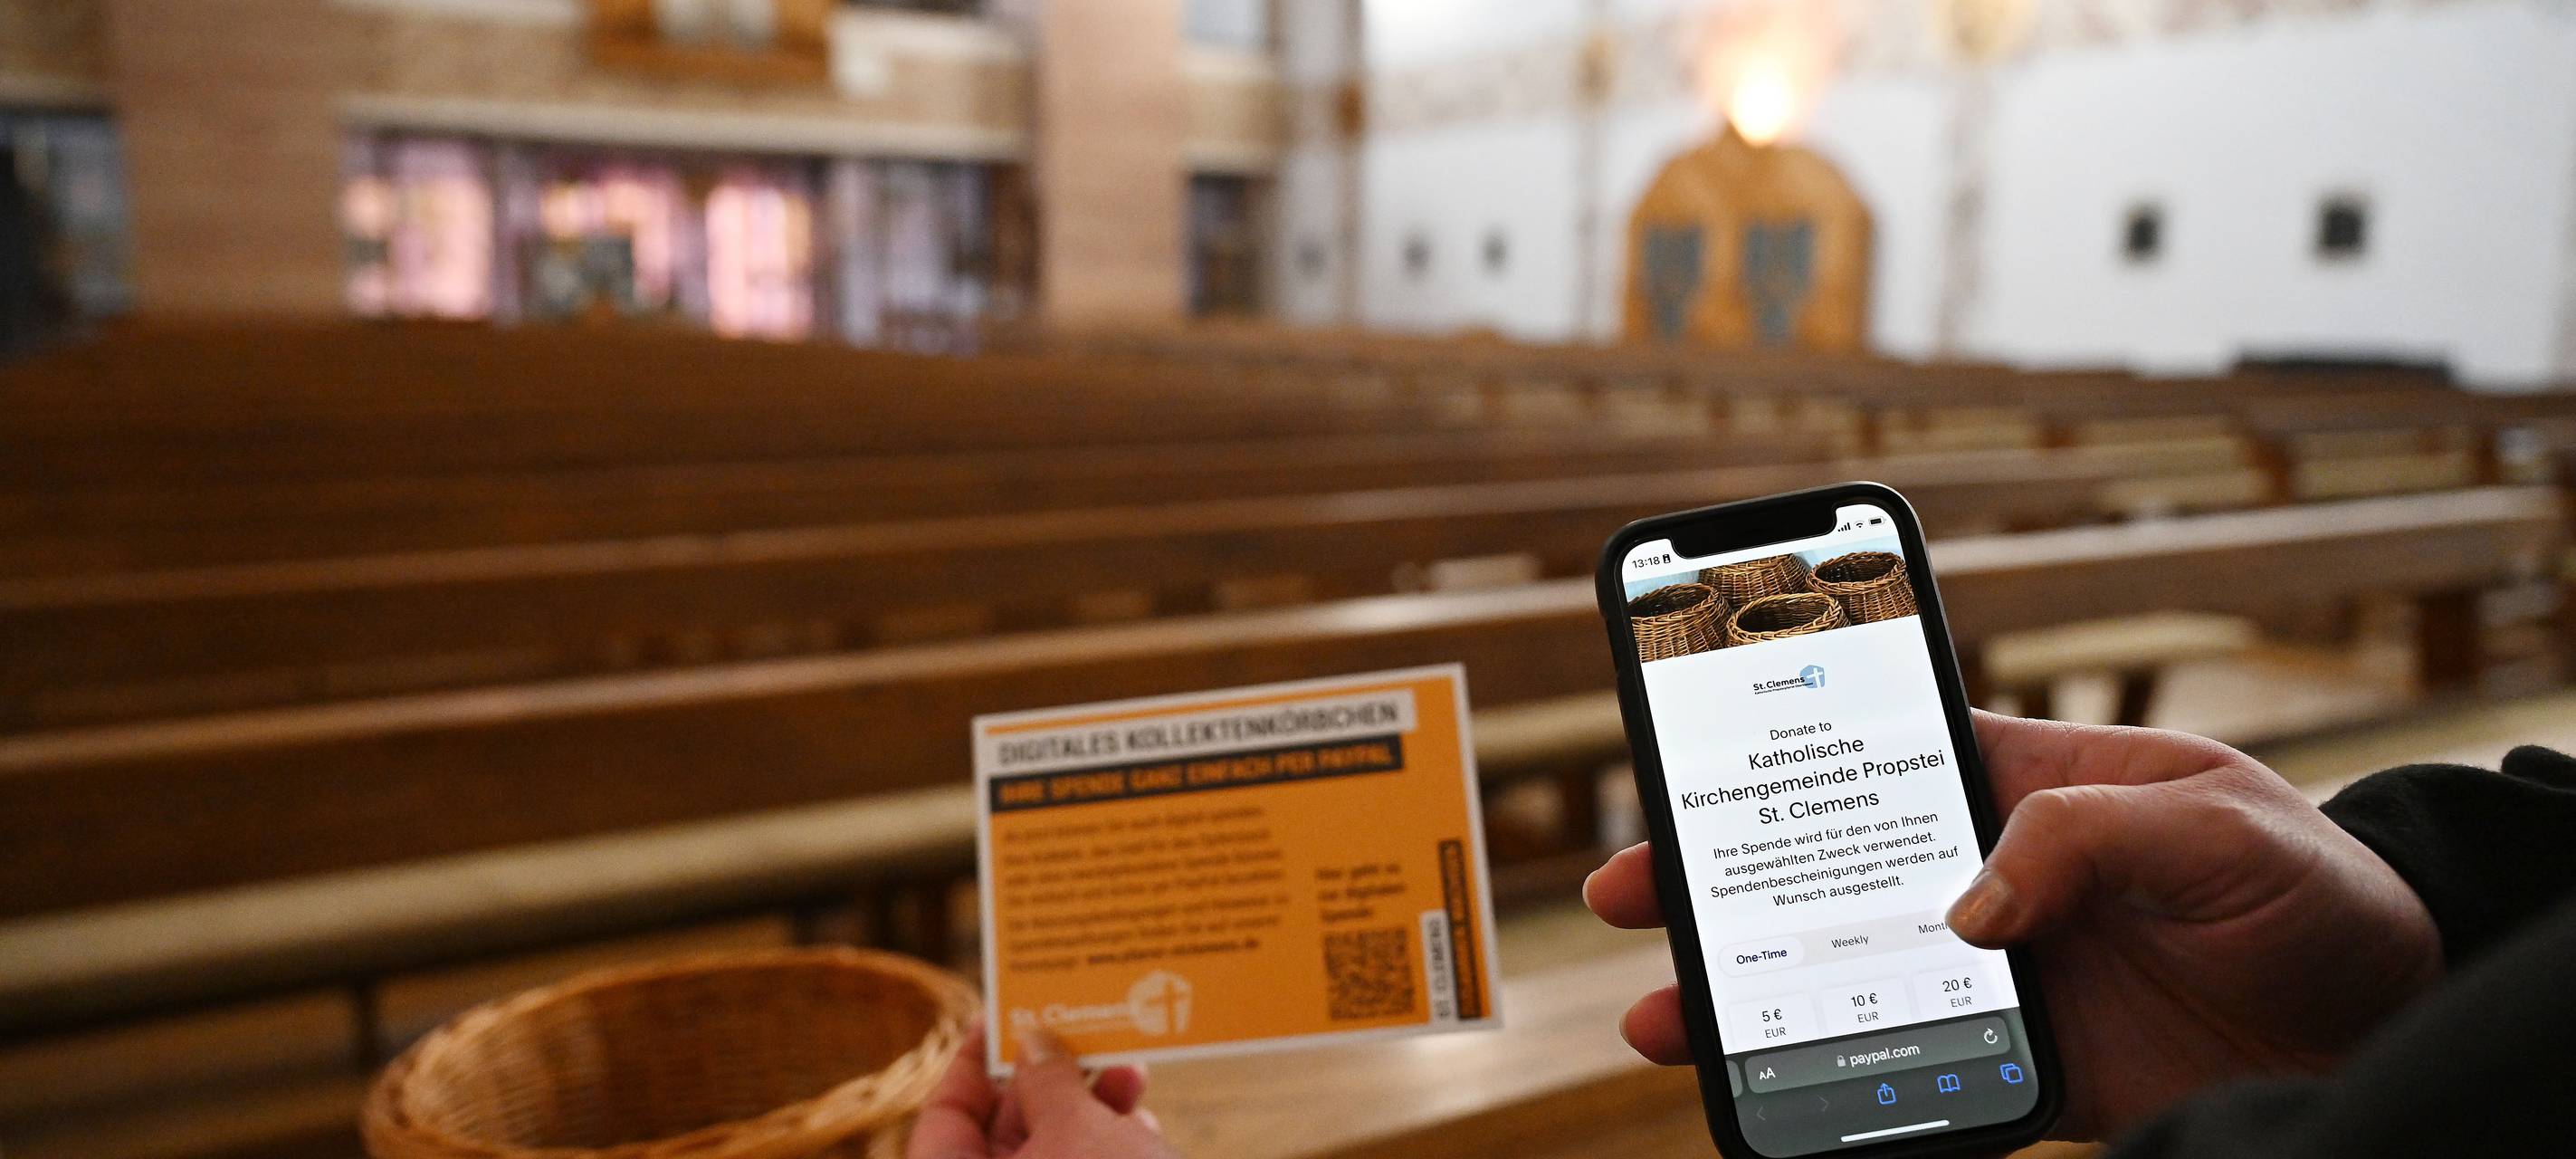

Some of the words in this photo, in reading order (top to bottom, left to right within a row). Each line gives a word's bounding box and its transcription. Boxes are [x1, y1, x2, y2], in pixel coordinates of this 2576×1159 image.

[1632, 556, 1661, 569] 13:18
[1770, 724, 1817, 741] Donate
[1818, 722, 1832, 733] to
[998, 731, 1121, 766] DIGITALES
[1748, 738, 1865, 771] Katholische
[1681, 766, 1858, 810] Kirchengemeinde
[1862, 749, 1945, 779] Propstei
[1759, 807, 1785, 825] St.
[1789, 792, 1880, 819] Clemens
[1713, 848, 1739, 860] Ihre
[1741, 837, 1792, 856] Spende
[1794, 830, 1823, 846] wird
[1825, 828, 1843, 840] für
[1846, 824, 1872, 838] den
[1873, 819, 1899, 832] von
[1901, 813, 1939, 828] Ihnen
[1724, 853, 1816, 876] ausgewählten
[1817, 844, 1862, 861] Zweck
[1863, 831, 1936, 853] verwendet.
[1711, 861, 1883, 899] Spendenbescheinigungen
[1884, 852, 1935, 868] werden
[1938, 845, 1959, 859] auf
[1772, 887, 1827, 906] Wunsch
[1829, 876, 1904, 897] ausgestellt.
[1831, 935, 1869, 949] Weekly
[1736, 949, 1788, 964] One-Time
[1942, 979, 1960, 992] 20
[1963, 977, 1972, 989] €
[1850, 994, 1865, 1008] 10
[1868, 992, 1878, 1005] €
[1950, 996, 1972, 1008] EUR
[1761, 1011, 1770, 1022] 5
[1773, 1008, 1782, 1020] €
[1857, 1011, 1879, 1023] EUR
[1764, 1027, 1787, 1039] EUR
[1849, 1045, 1921, 1068] paypal.com
